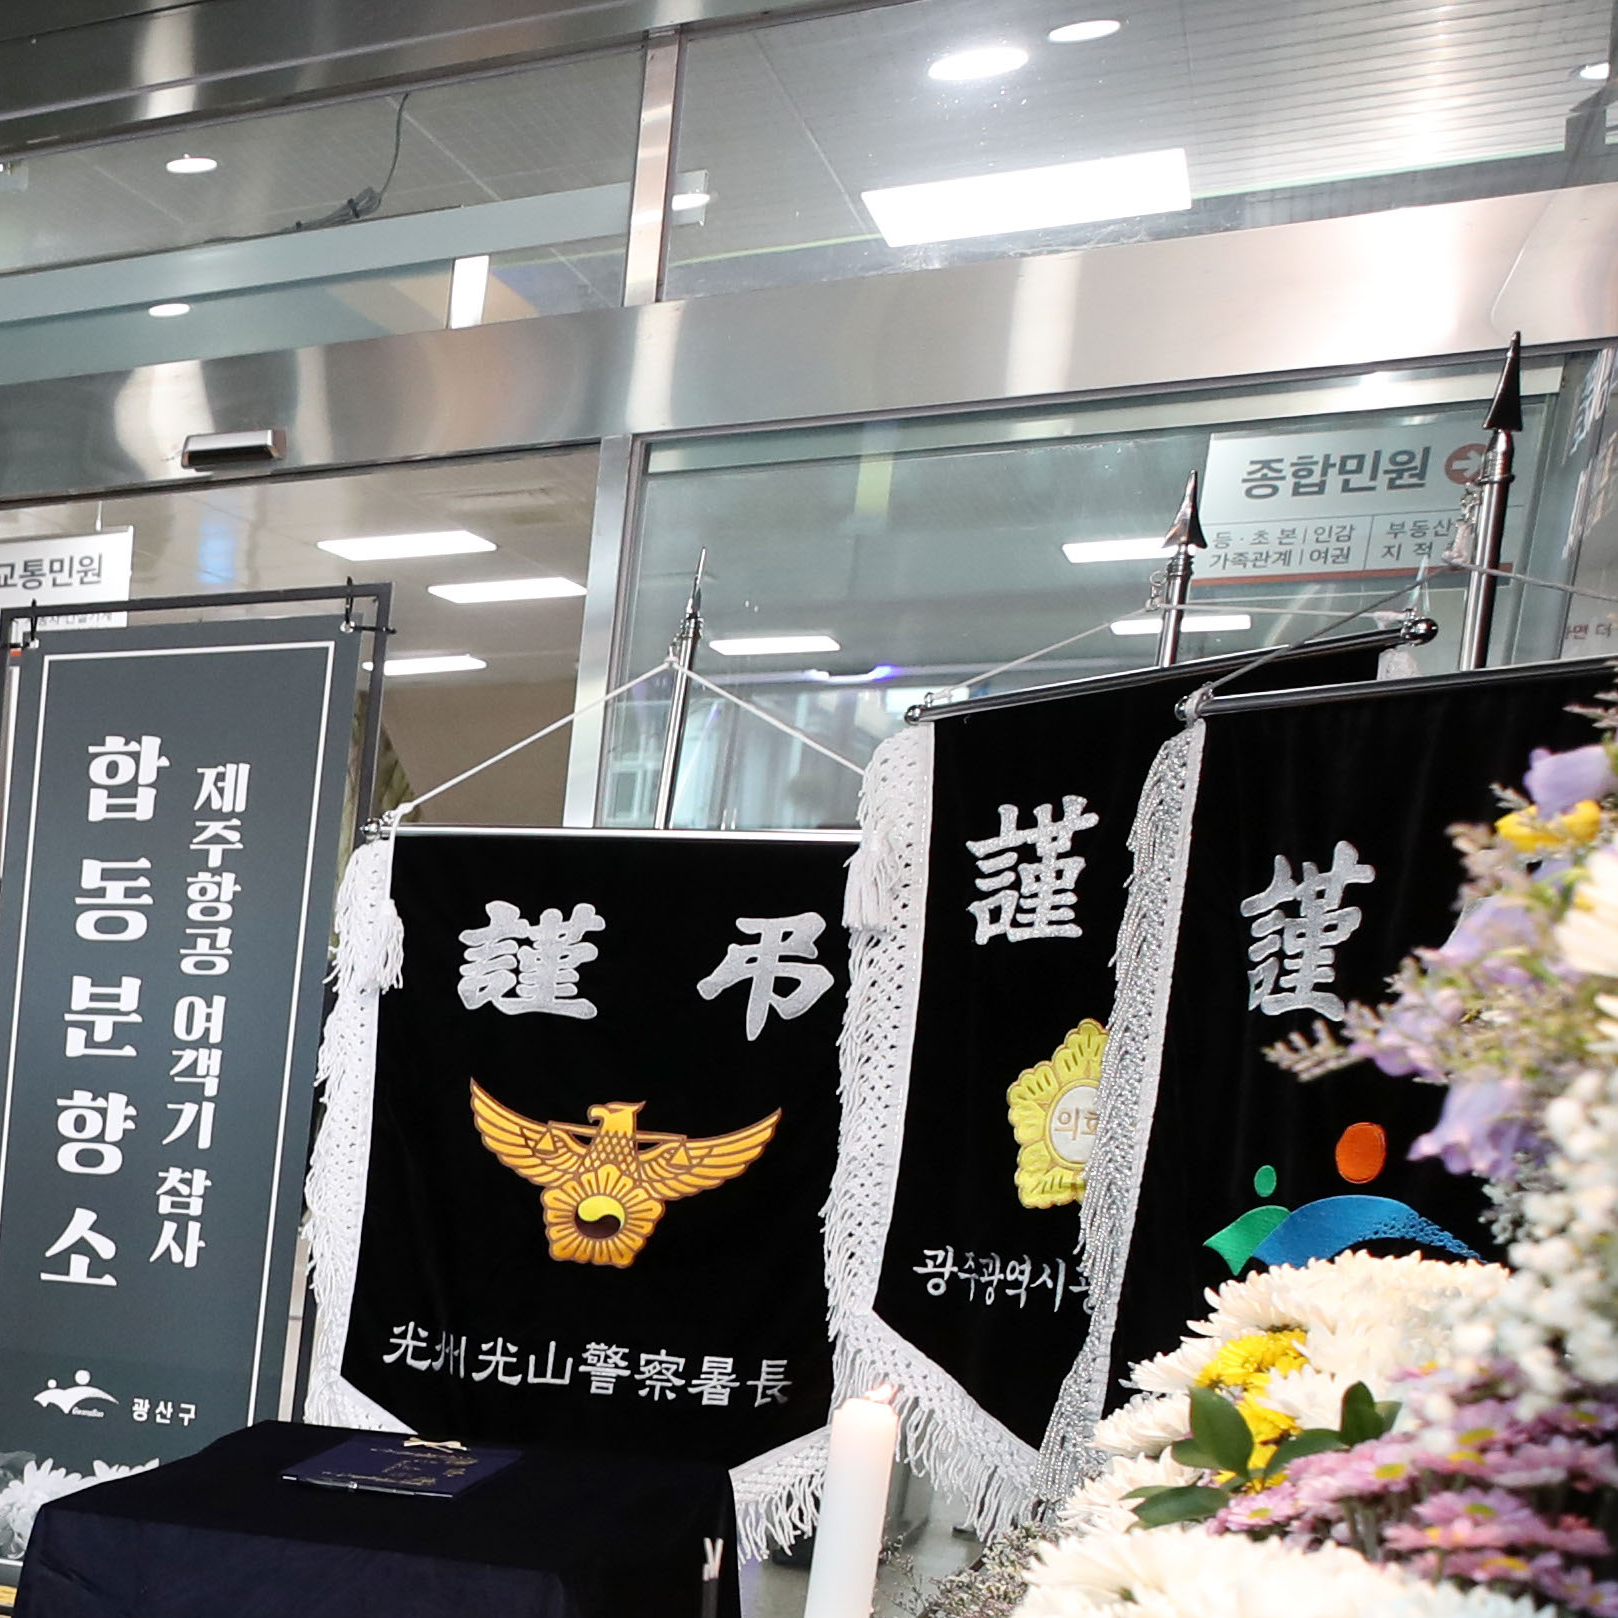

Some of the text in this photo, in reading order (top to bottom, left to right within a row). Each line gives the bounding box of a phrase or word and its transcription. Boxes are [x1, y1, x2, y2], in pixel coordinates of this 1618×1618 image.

[1241, 446, 1431, 500] 종합민원
[1209, 546, 1351, 570] 가족관계 여권
[1314, 524, 1355, 544] 인감
[965, 794, 1100, 946] 謹
[1240, 840, 1376, 1022] 謹
[149, 762, 252, 1269] 제주항공 여객기 참사
[131, 1397, 197, 1427] 광산구
